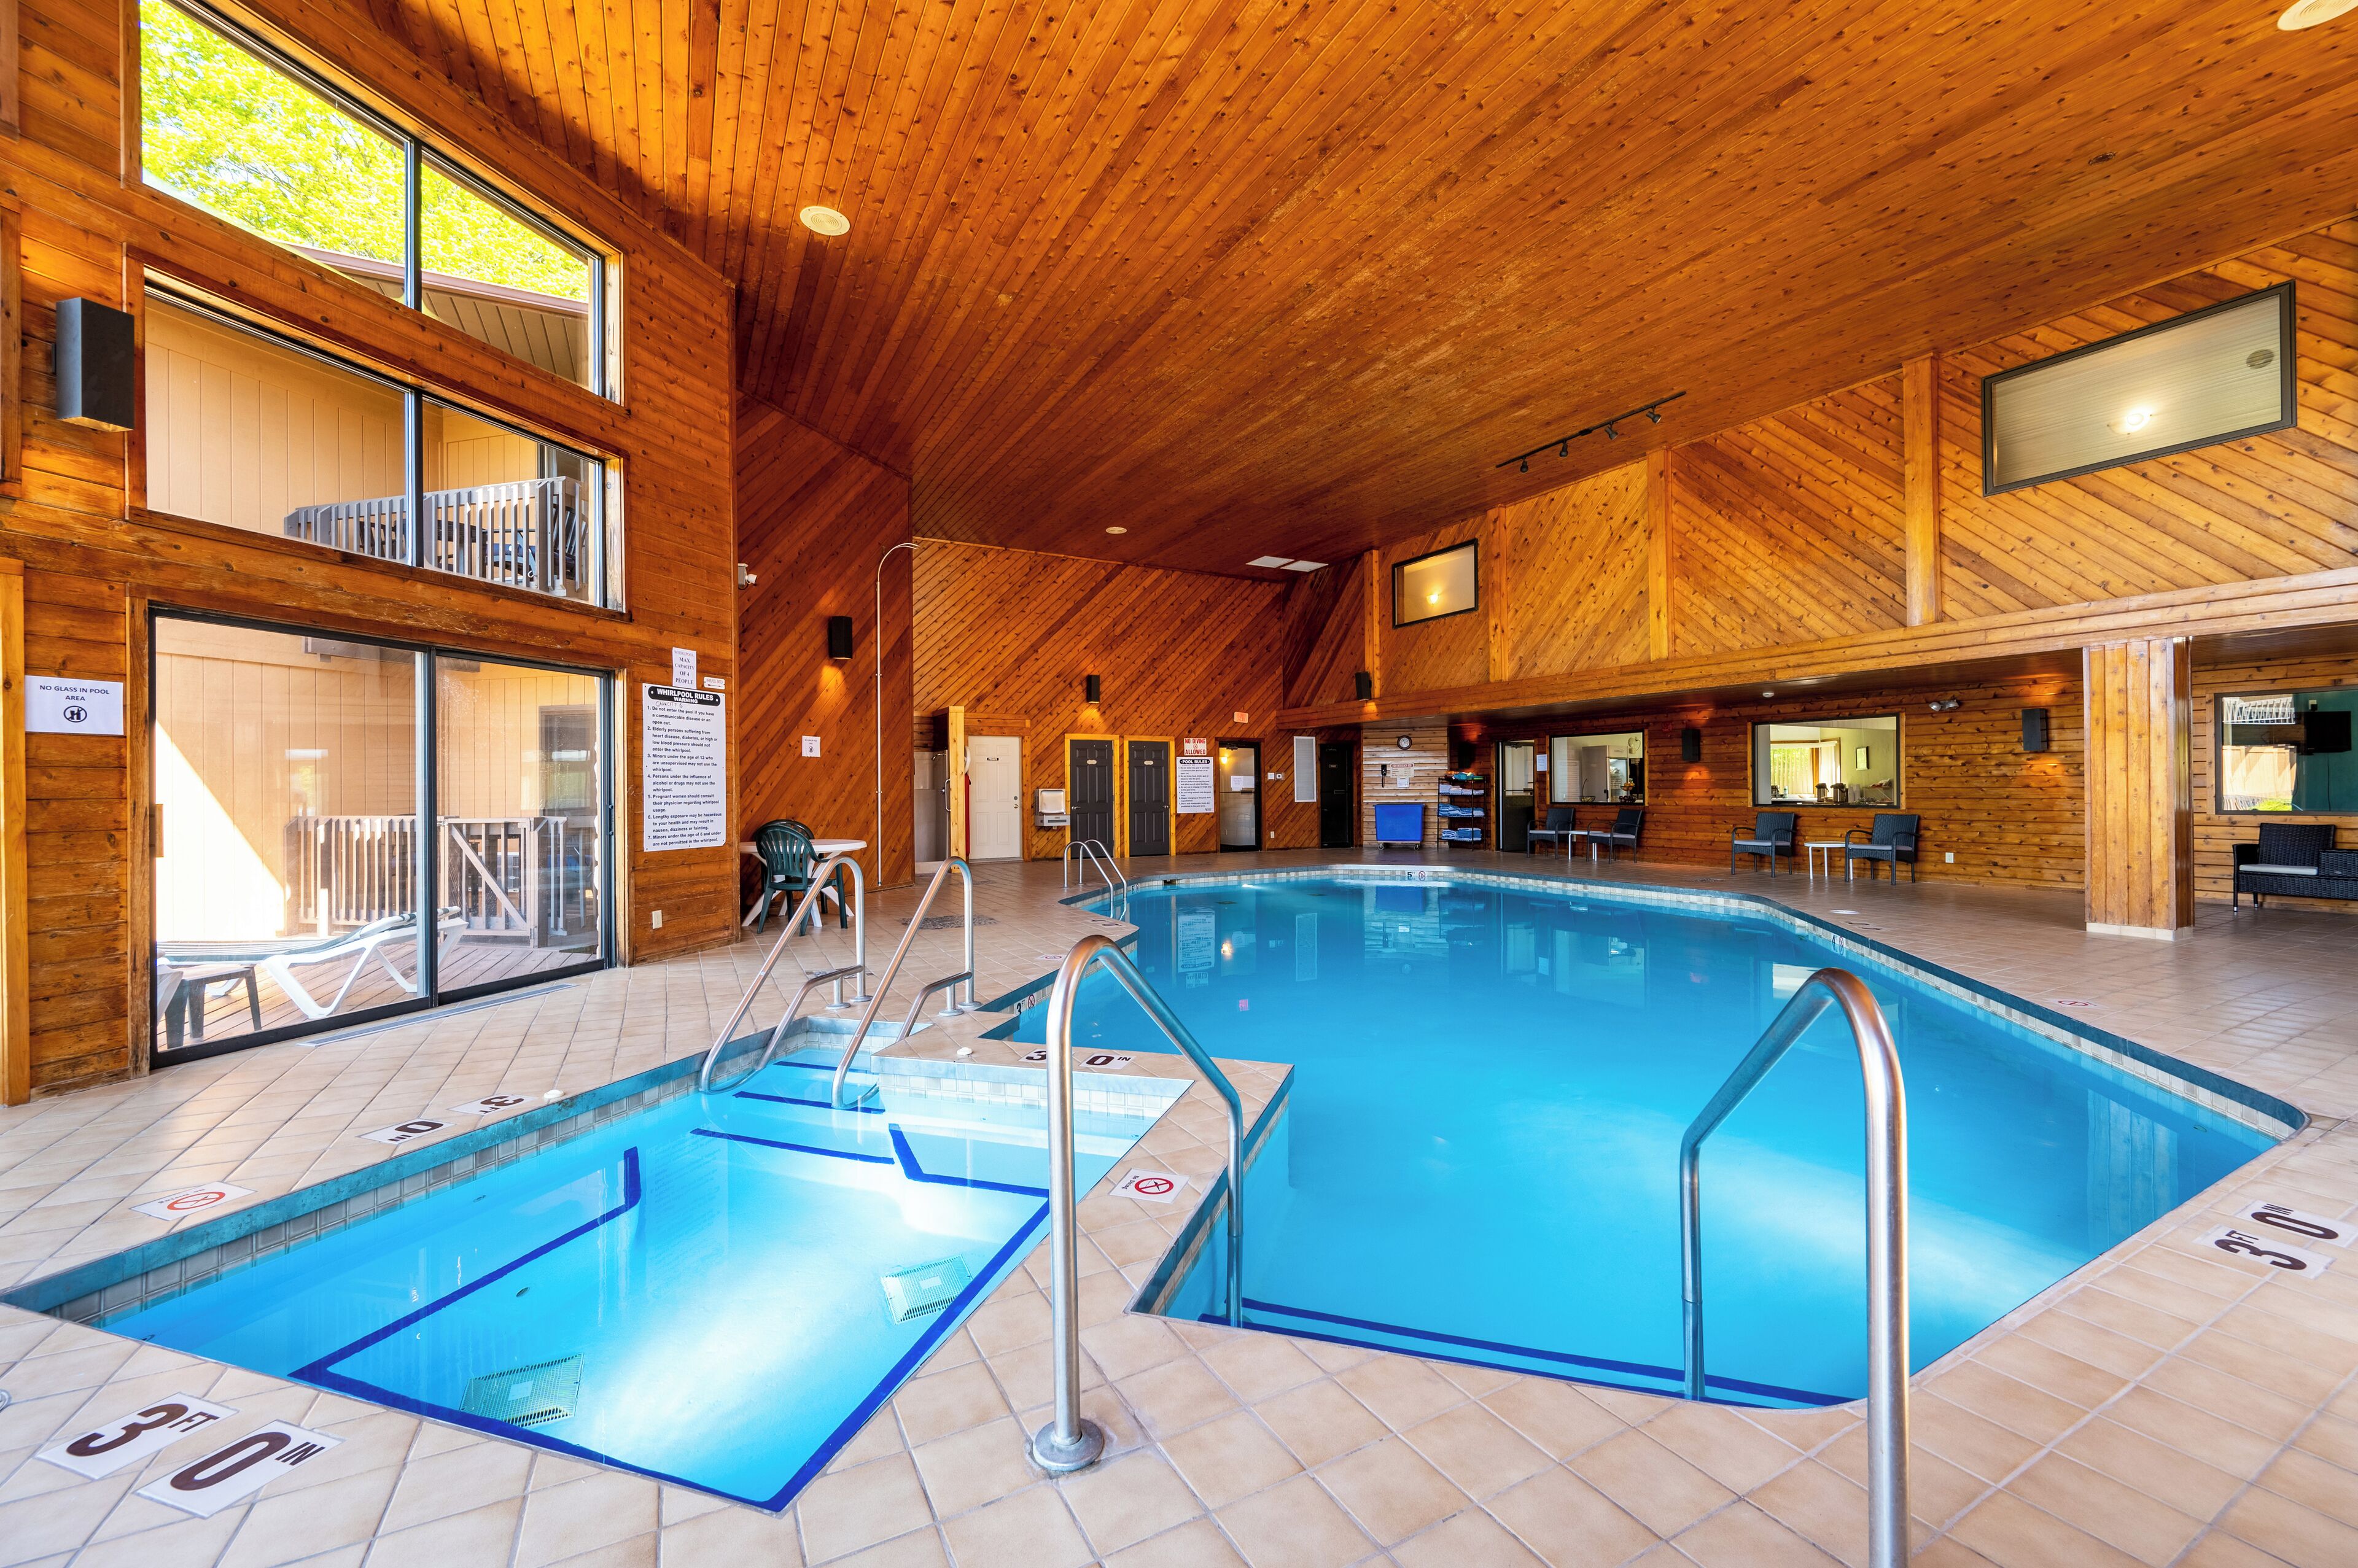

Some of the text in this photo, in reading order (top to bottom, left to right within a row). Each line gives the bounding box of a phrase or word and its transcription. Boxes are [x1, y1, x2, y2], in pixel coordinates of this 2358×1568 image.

[657, 688, 693, 699] WHIRLPOOL
[1017, 1003, 1022, 1015] 3
[1025, 1050, 1046, 1061] 3
[1086, 1055, 1115, 1066] 0
[480, 1096, 524, 1106] 3
[394, 1121, 443, 1133] 0
[2251, 1203, 2338, 1240] 0 IN
[2214, 1230, 2306, 1270] 3 FT
[66, 1403, 220, 1457] 3 FT
[170, 1432, 326, 1491] 0 IN
